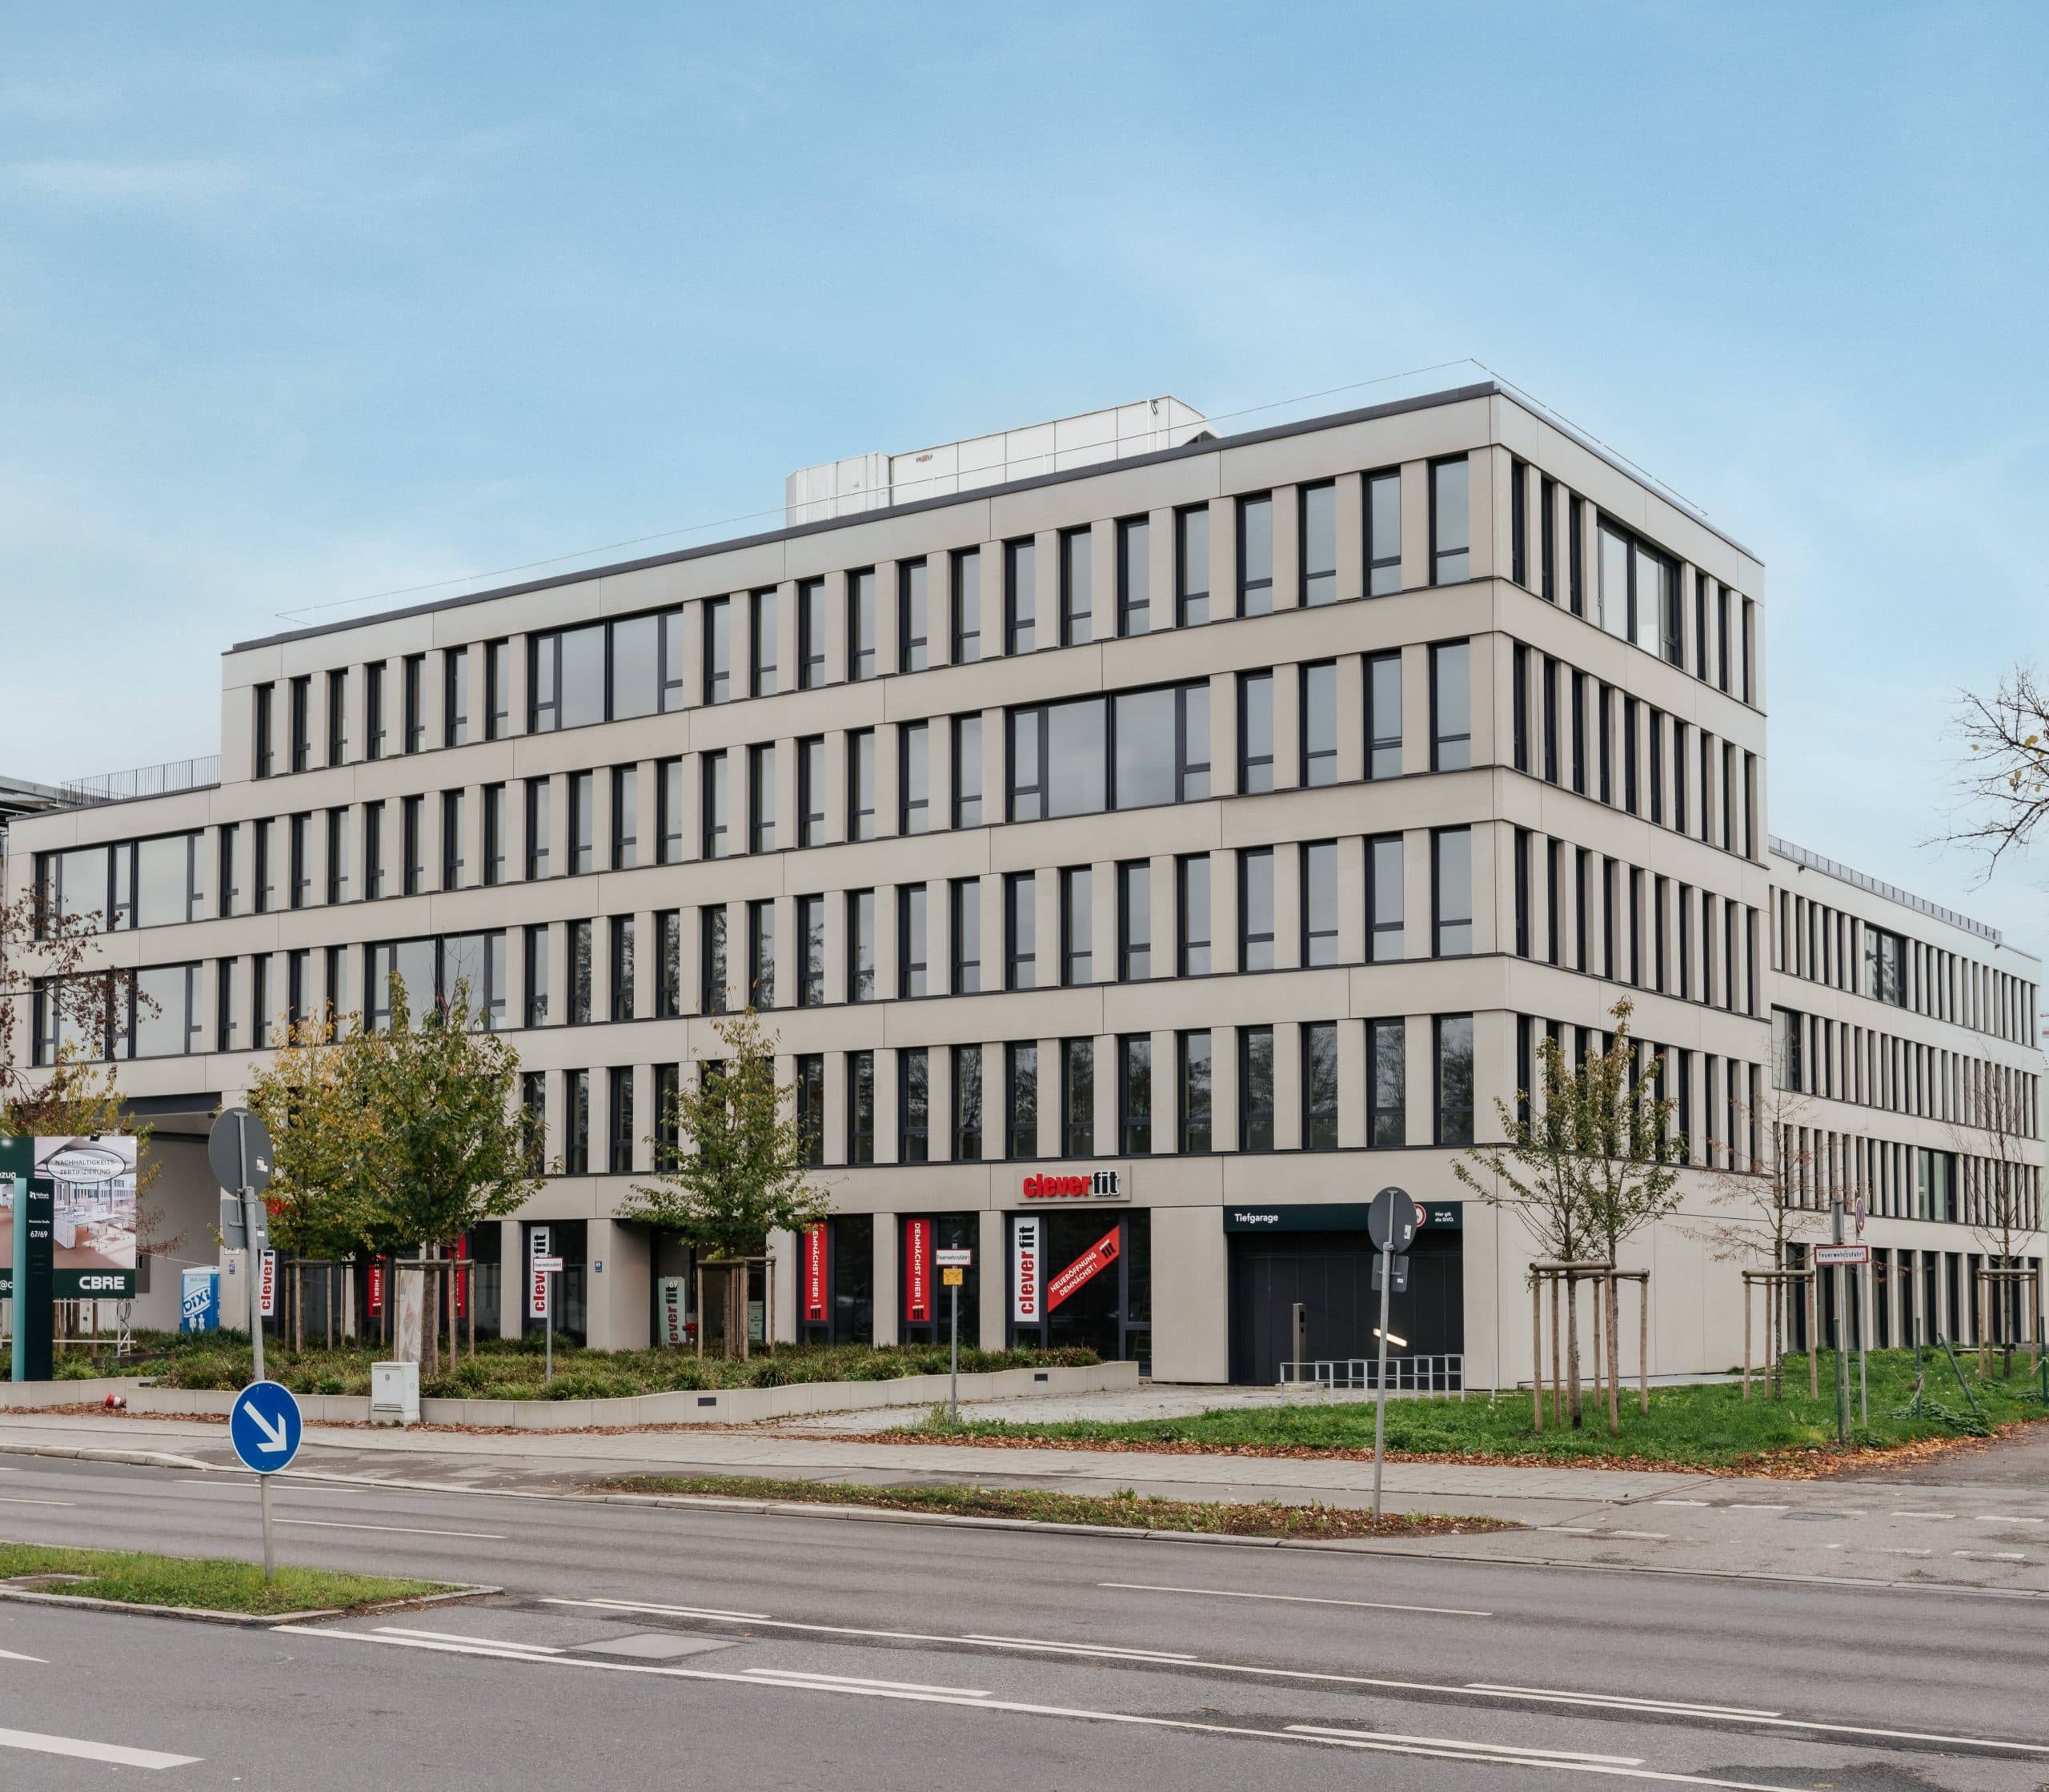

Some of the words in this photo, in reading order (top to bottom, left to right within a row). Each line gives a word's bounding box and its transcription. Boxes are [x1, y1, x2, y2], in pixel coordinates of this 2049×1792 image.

[0, 1172, 16, 1180] zug
[1234, 1213, 1279, 1224] Tiefgarage
[914, 1223, 922, 1276] DEMNÄCHST
[1818, 1250, 1864, 1258] Feuerwehrzufahrt
[1050, 1252, 1097, 1293] NEUERÖFFNUNG
[78, 1276, 125, 1290] CBRE
[669, 1280, 679, 1288] 69
[1059, 1264, 1093, 1296] DEMNÄCHST
